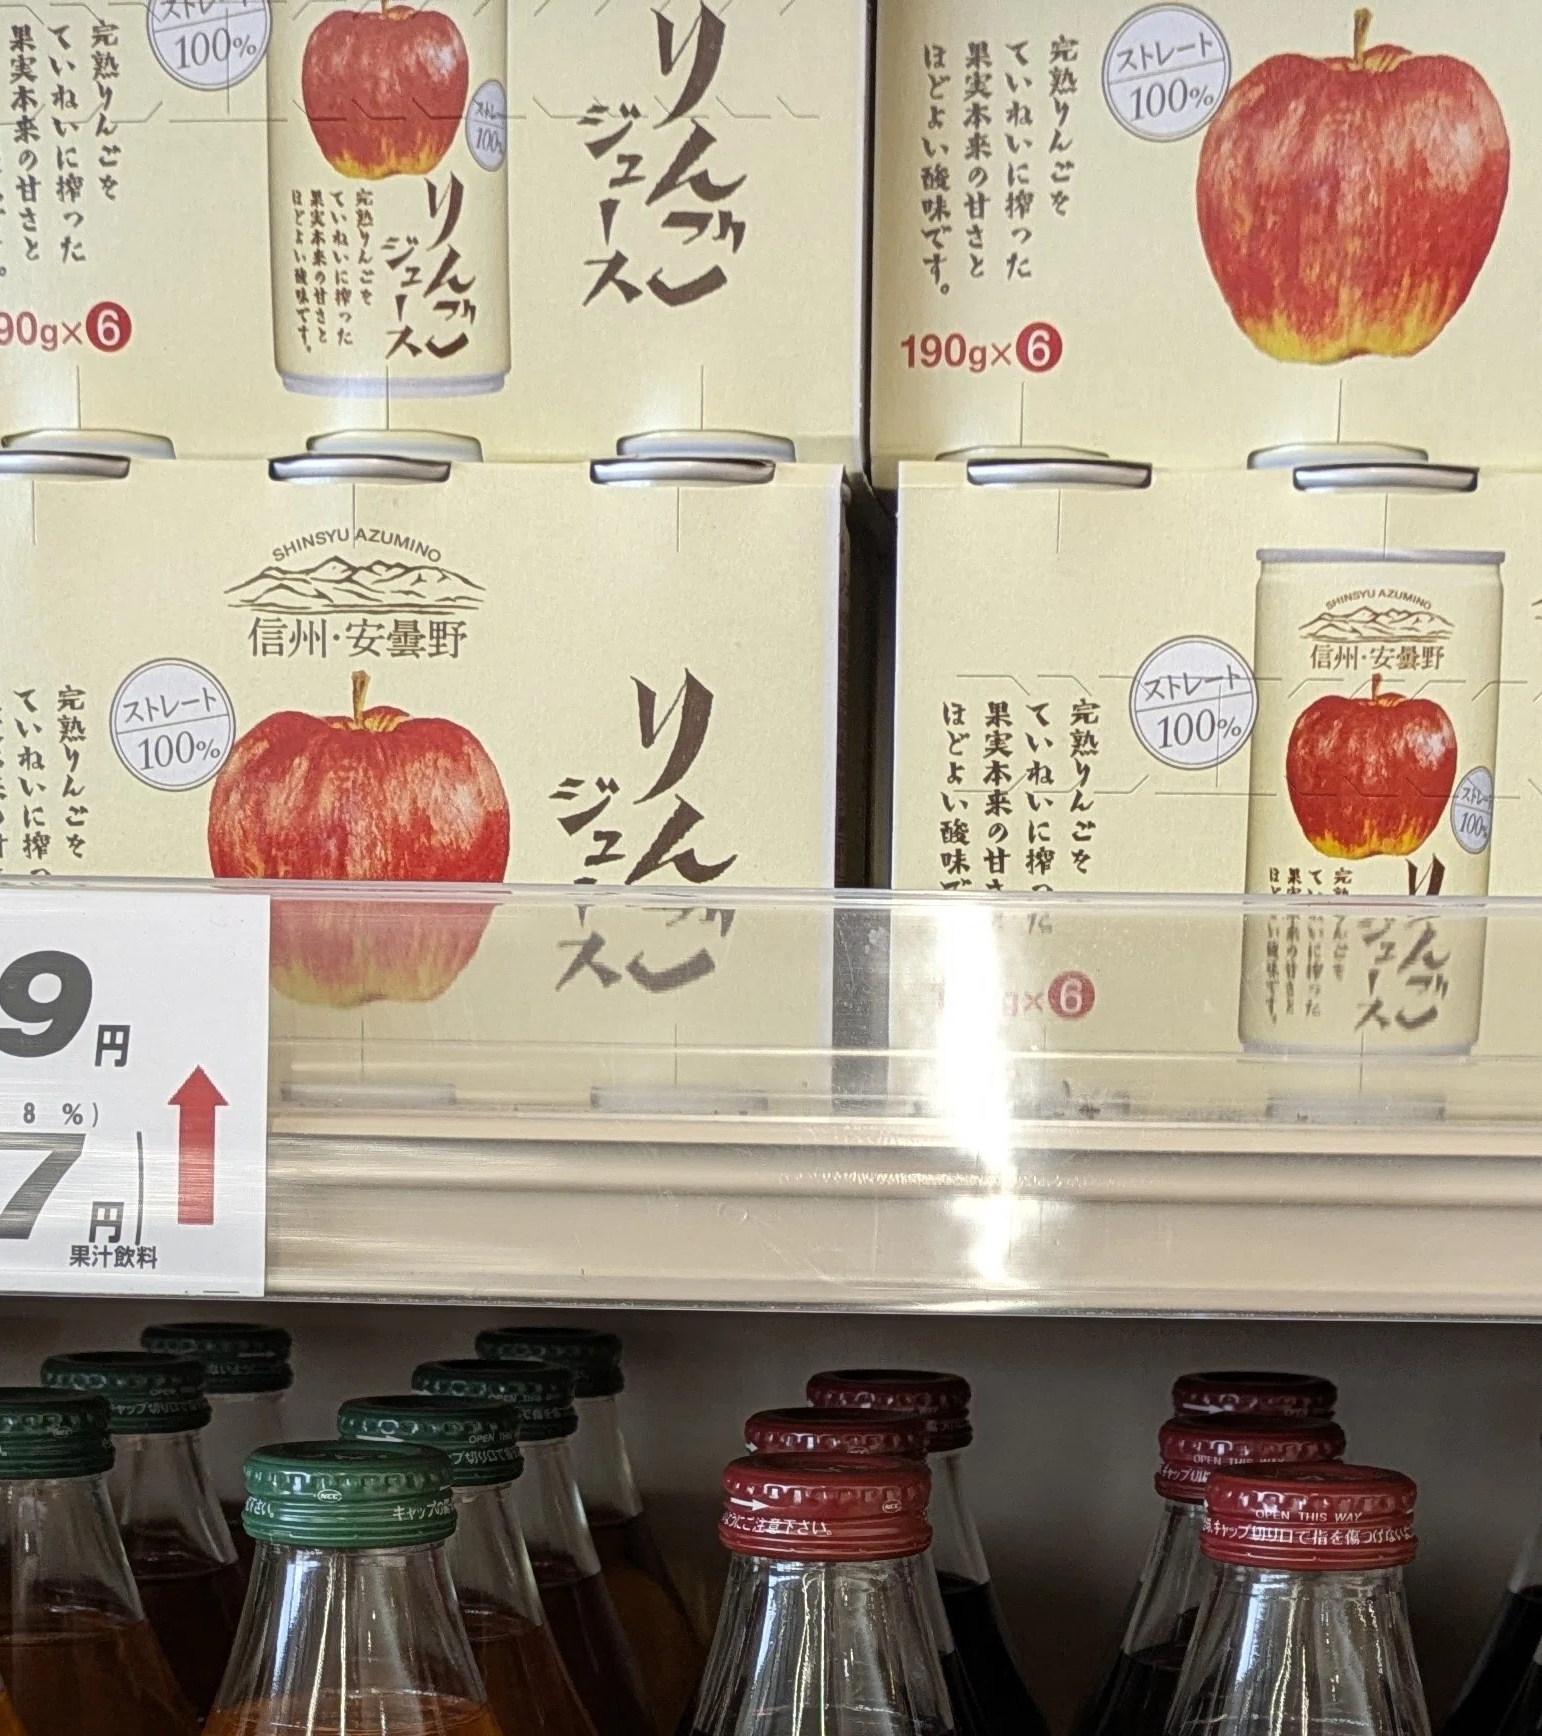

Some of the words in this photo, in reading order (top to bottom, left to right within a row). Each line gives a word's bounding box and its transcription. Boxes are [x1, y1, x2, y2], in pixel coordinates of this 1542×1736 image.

[1116, 33, 1215, 75] ストレート
[89, 20, 122, 202] 完熟りんごを
[8, 25, 42, 262] 果実本来の甘さと
[46, 25, 87, 262] ていねいに搾った
[138, 731, 221, 772] 100%
[68, 1244, 159, 1269] 果汁飲料
[1255, 1510, 1290, 1520] OPEN
[1298, 1512, 1328, 1522] THIS
[1335, 1511, 1362, 1522] WAY
